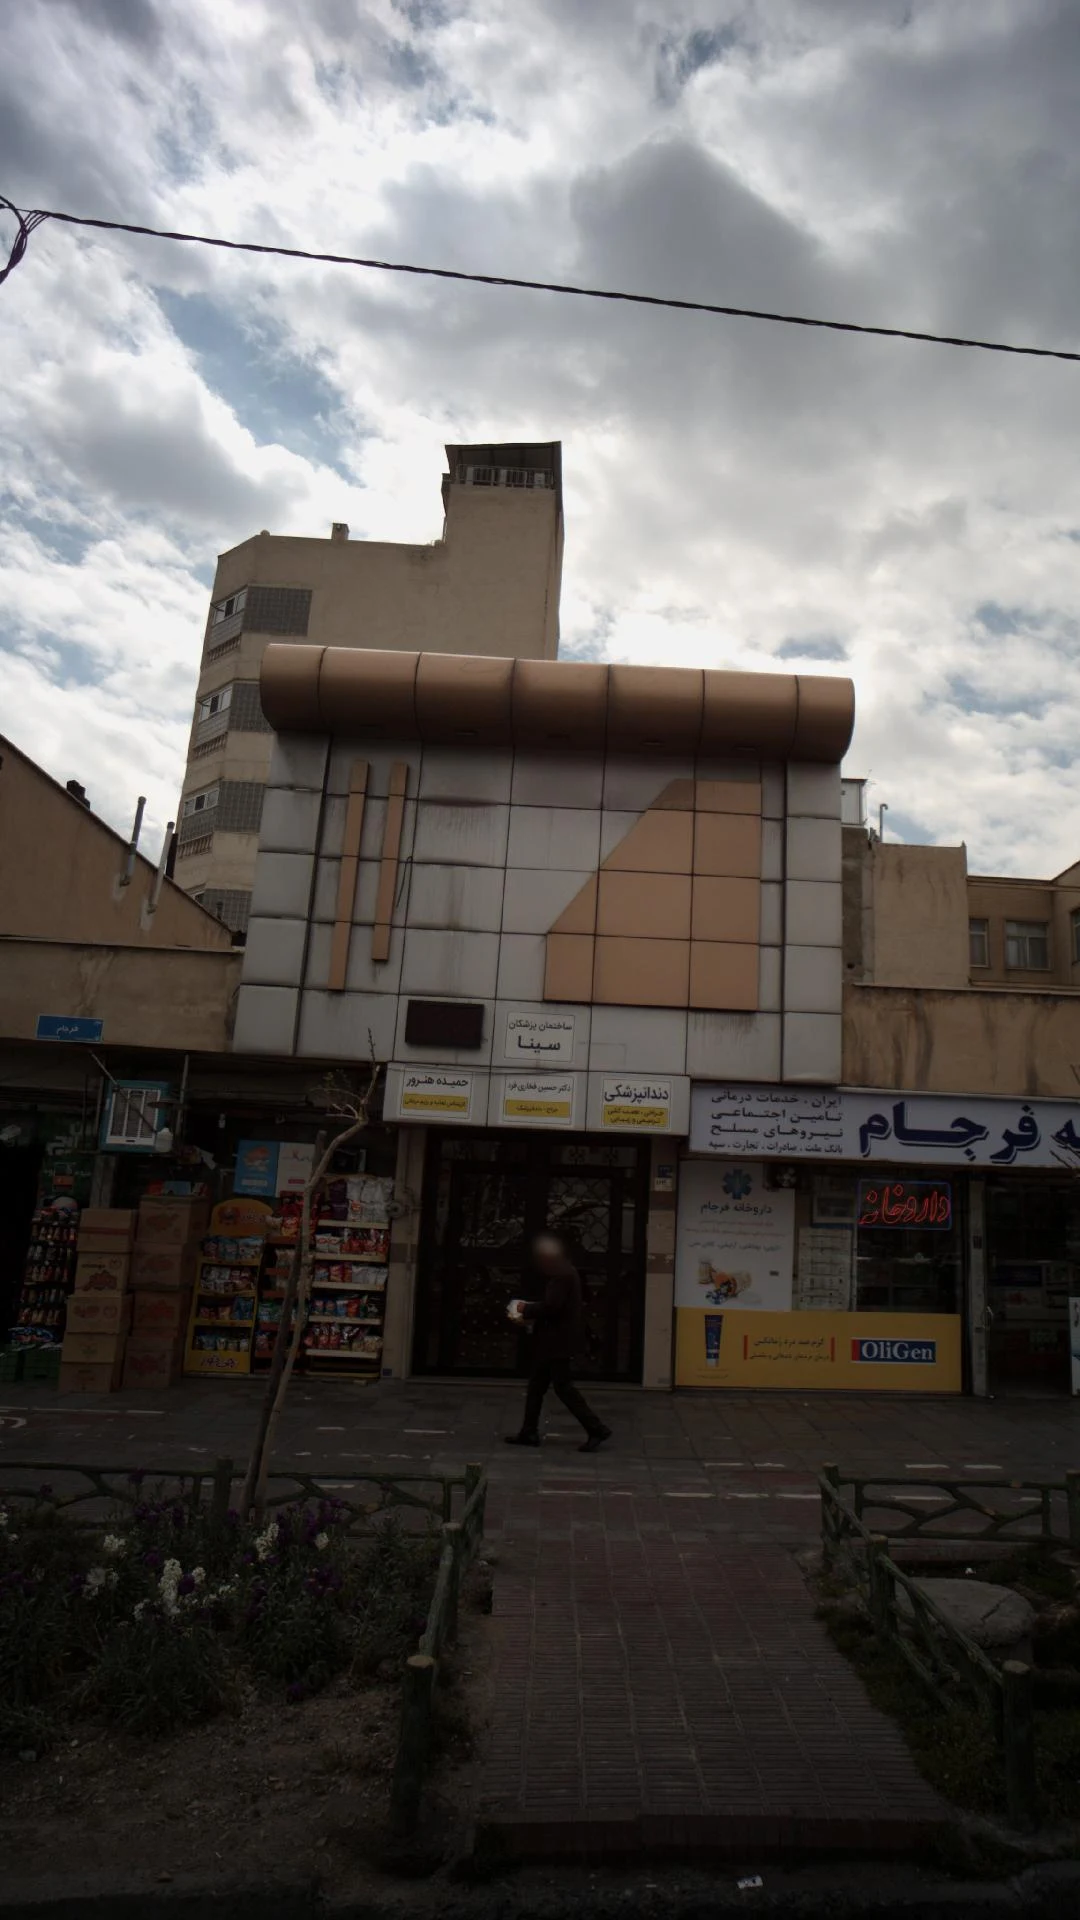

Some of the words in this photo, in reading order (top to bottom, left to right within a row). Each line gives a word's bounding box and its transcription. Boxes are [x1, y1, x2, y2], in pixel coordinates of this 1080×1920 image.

[508, 1019, 537, 1031] پزشکان
[538, 1021, 573, 1032] ساختمان
[517, 1035, 561, 1053] سینا
[436, 1077, 468, 1088] حمیده
[558, 1083, 571, 1093] دکتر
[538, 1085, 557, 1093] حسین
[604, 1084, 669, 1104] دندانپزشکی
[711, 1088, 752, 1103] درمانی
[756, 1092, 798, 1103] خدمات
[811, 1095, 842, 1109] ایران
[711, 1107, 786, 1121] اجتماعی
[790, 1111, 842, 1123] تامین
[711, 1123, 759, 1136] مسلح
[763, 1125, 843, 1140] نیروهای
[859, 1101, 1041, 1164] فرجام
[708, 1141, 726, 1149] سپه
[733, 1140, 759, 1152] تجارت
[766, 1142, 797, 1153] صادرات
[805, 1144, 822, 1152] ملت
[824, 1145, 843, 1154] بانک
[700, 1200, 730, 1215] فرجام
[733, 1203, 773, 1216] داروخانه
[858, 1183, 950, 1225] داروخانه
[861, 1341, 934, 1361] OliGen
